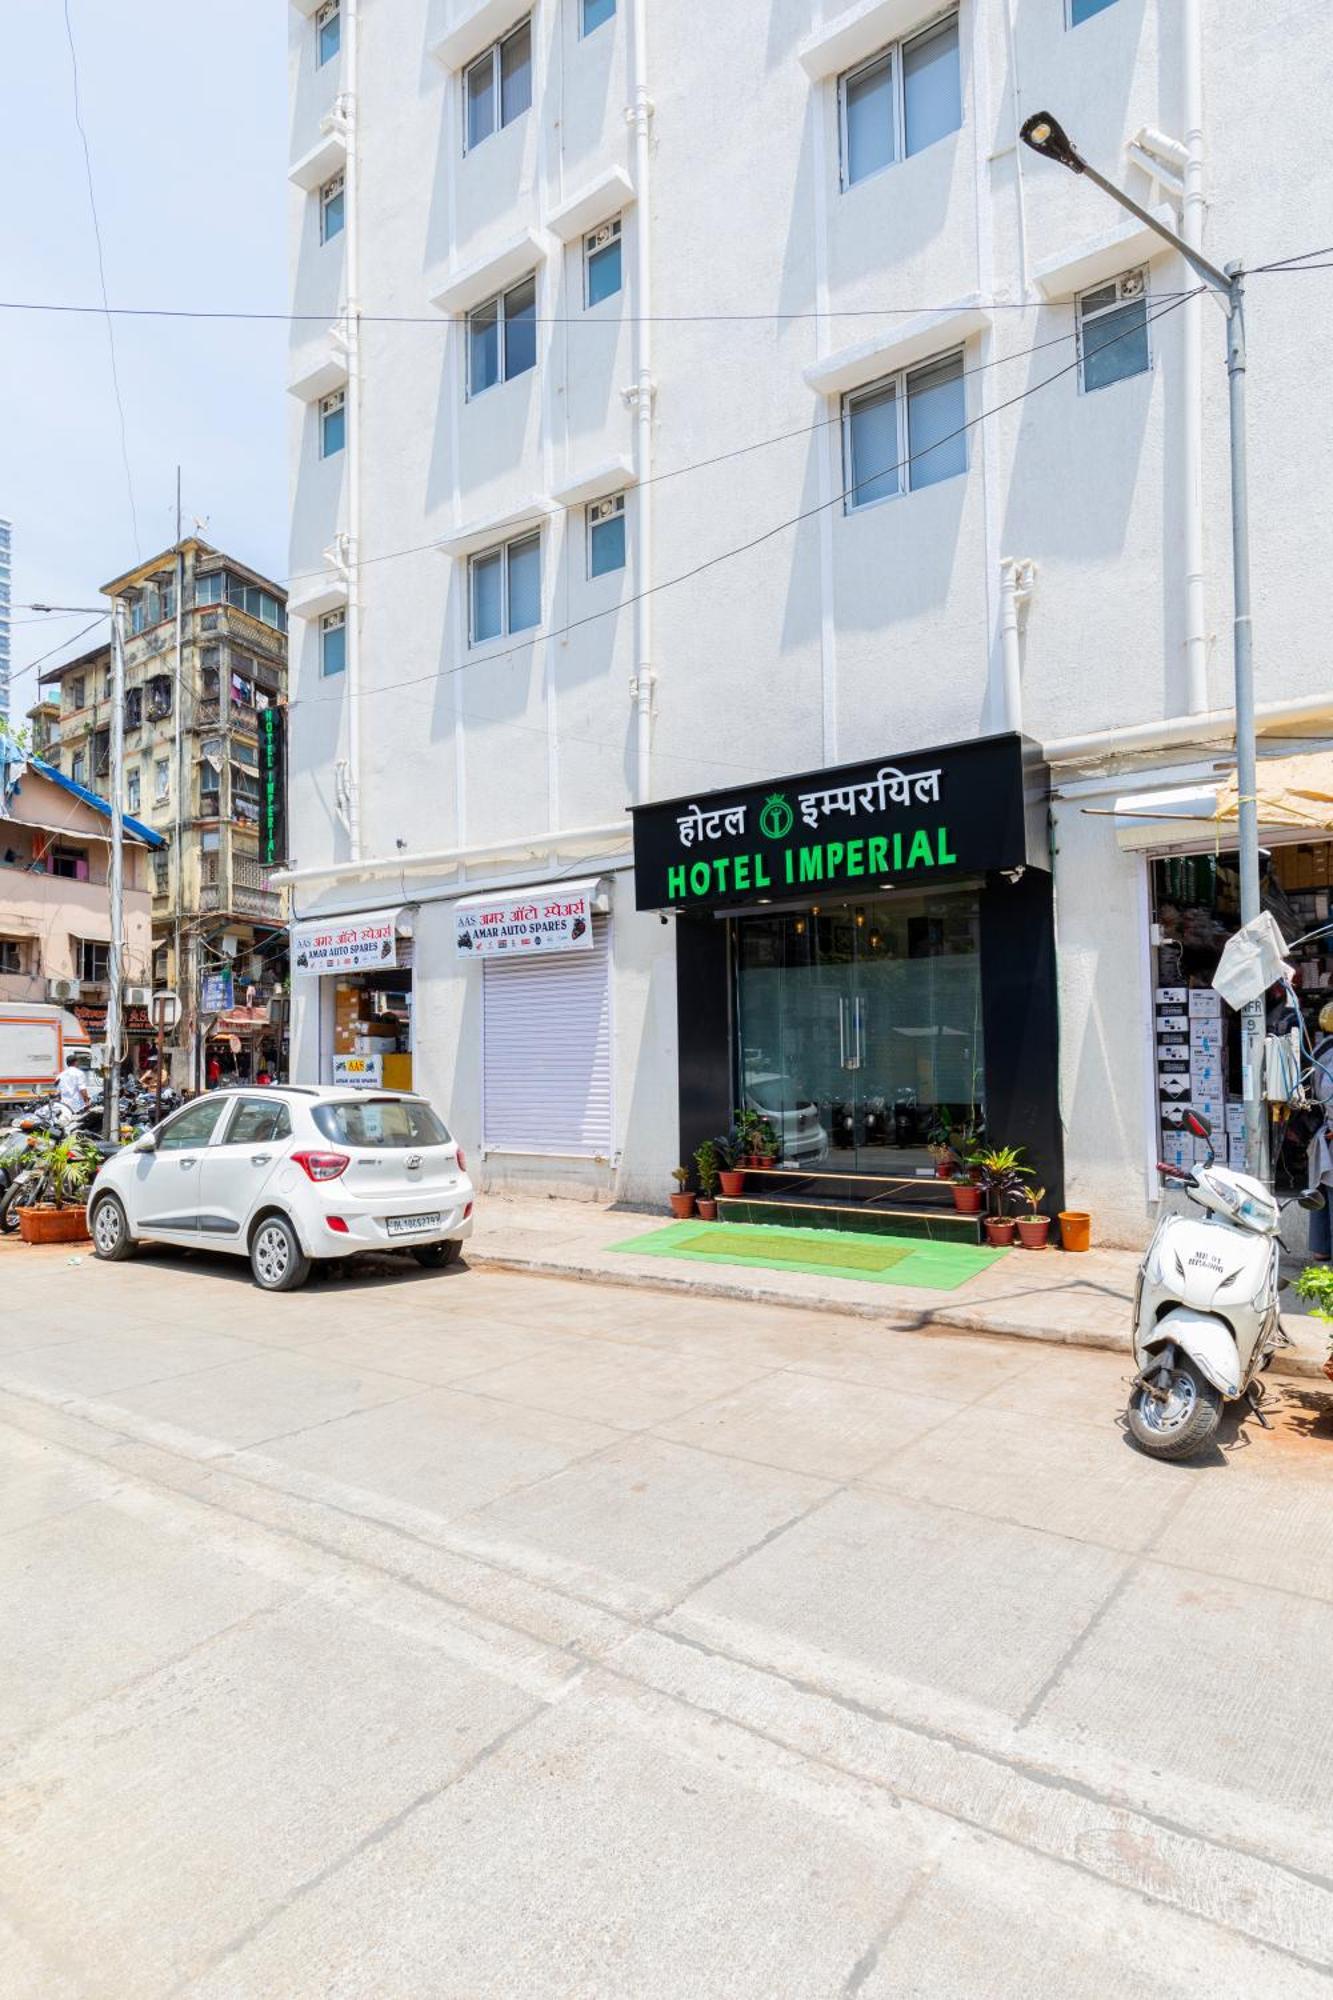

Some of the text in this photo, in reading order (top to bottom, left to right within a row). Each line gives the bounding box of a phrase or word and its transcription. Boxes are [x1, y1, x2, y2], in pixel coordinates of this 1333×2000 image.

[265, 708, 276, 863] HOTEL IMPERIAL
[677, 804, 748, 848] होटल
[667, 827, 957, 899] HOTEL IMPERIAL
[480, 910, 505, 926] अमर
[472, 919, 568, 940] AMAR AUTO SPARES
[308, 941, 378, 960] AMAR AUTO SPARES
[313, 934, 333, 947] अमर
[1247, 1019, 1257, 1031] 9
